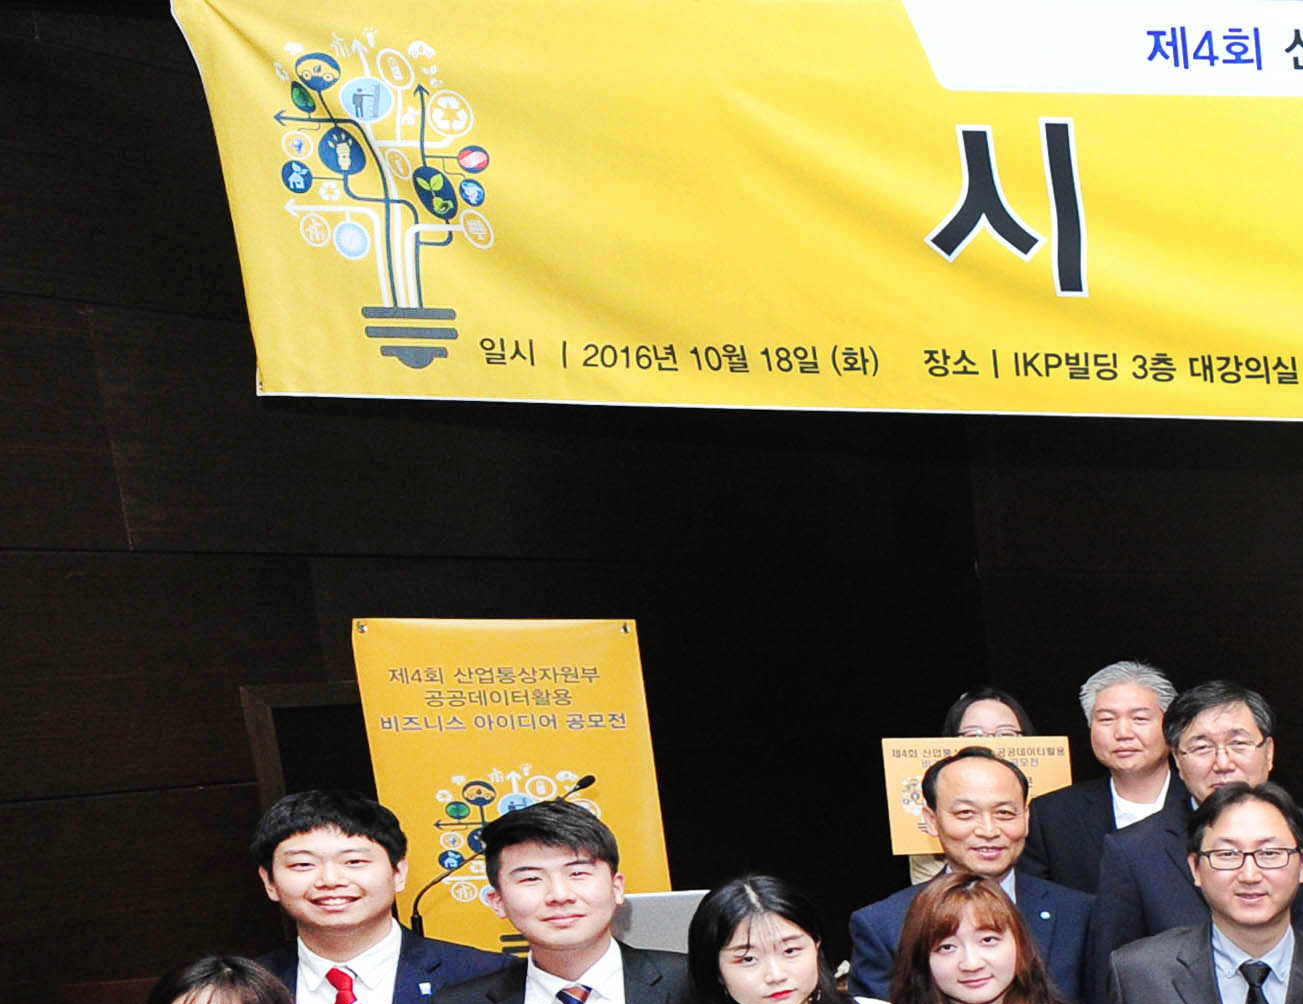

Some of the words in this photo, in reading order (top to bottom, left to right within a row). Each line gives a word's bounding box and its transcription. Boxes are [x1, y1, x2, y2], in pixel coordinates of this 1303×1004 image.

[1146, 26, 1264, 70] 제4회
[925, 117, 1089, 297] 시
[480, 337, 534, 367] 일시
[583, 343, 678, 372] 2016년
[690, 344, 750, 373] 10월
[762, 346, 819, 374] 18일
[831, 345, 879, 376] (화)
[923, 349, 980, 378] 장소
[1014, 352, 1118, 381] IKP빌딩
[1132, 353, 1177, 382] 3층
[1189, 355, 1299, 385] 대강의실
[388, 667, 444, 685] 제4회
[453, 666, 601, 684] 산업통상자원부
[424, 689, 573, 708] 공공데이터활용
[380, 714, 466, 732] 비즈니스
[474, 713, 558, 731] 아이디어
[567, 712, 627, 729] 공모전
